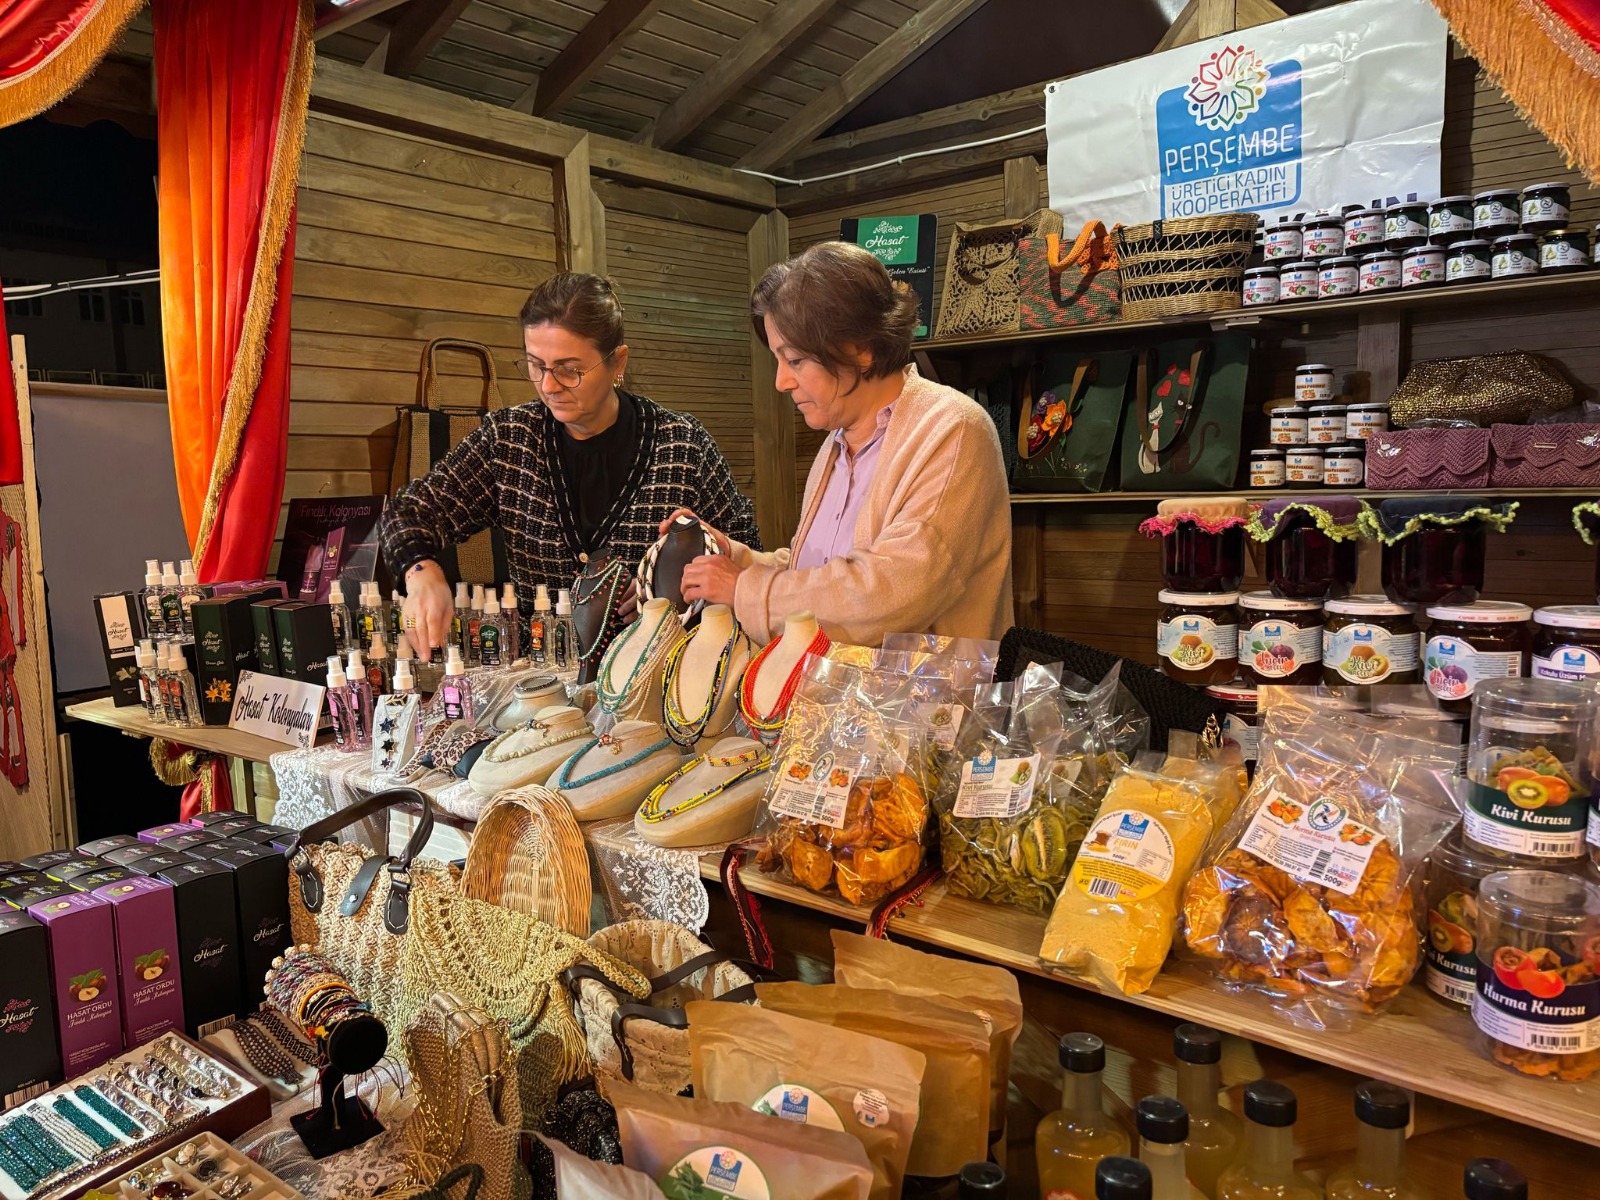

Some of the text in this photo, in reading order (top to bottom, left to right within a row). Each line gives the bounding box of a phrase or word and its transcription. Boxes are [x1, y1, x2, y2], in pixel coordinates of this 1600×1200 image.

[1165, 123, 1295, 176] PERŞEMBE
[1235, 166, 1287, 189] KADIN
[865, 235, 909, 248] Hasat
[234, 684, 270, 722] Hasat
[1491, 803, 1572, 825] Kivi Kurusu
[1323, 874, 1342, 887] 500g
[253, 922, 285, 942] Hasat
[193, 943, 229, 963] Hasat
[133, 979, 175, 998] HASAT ORDU
[1483, 982, 1586, 1017] Hurma Kurusu
[67, 1000, 113, 1020] HASAT ORDU
